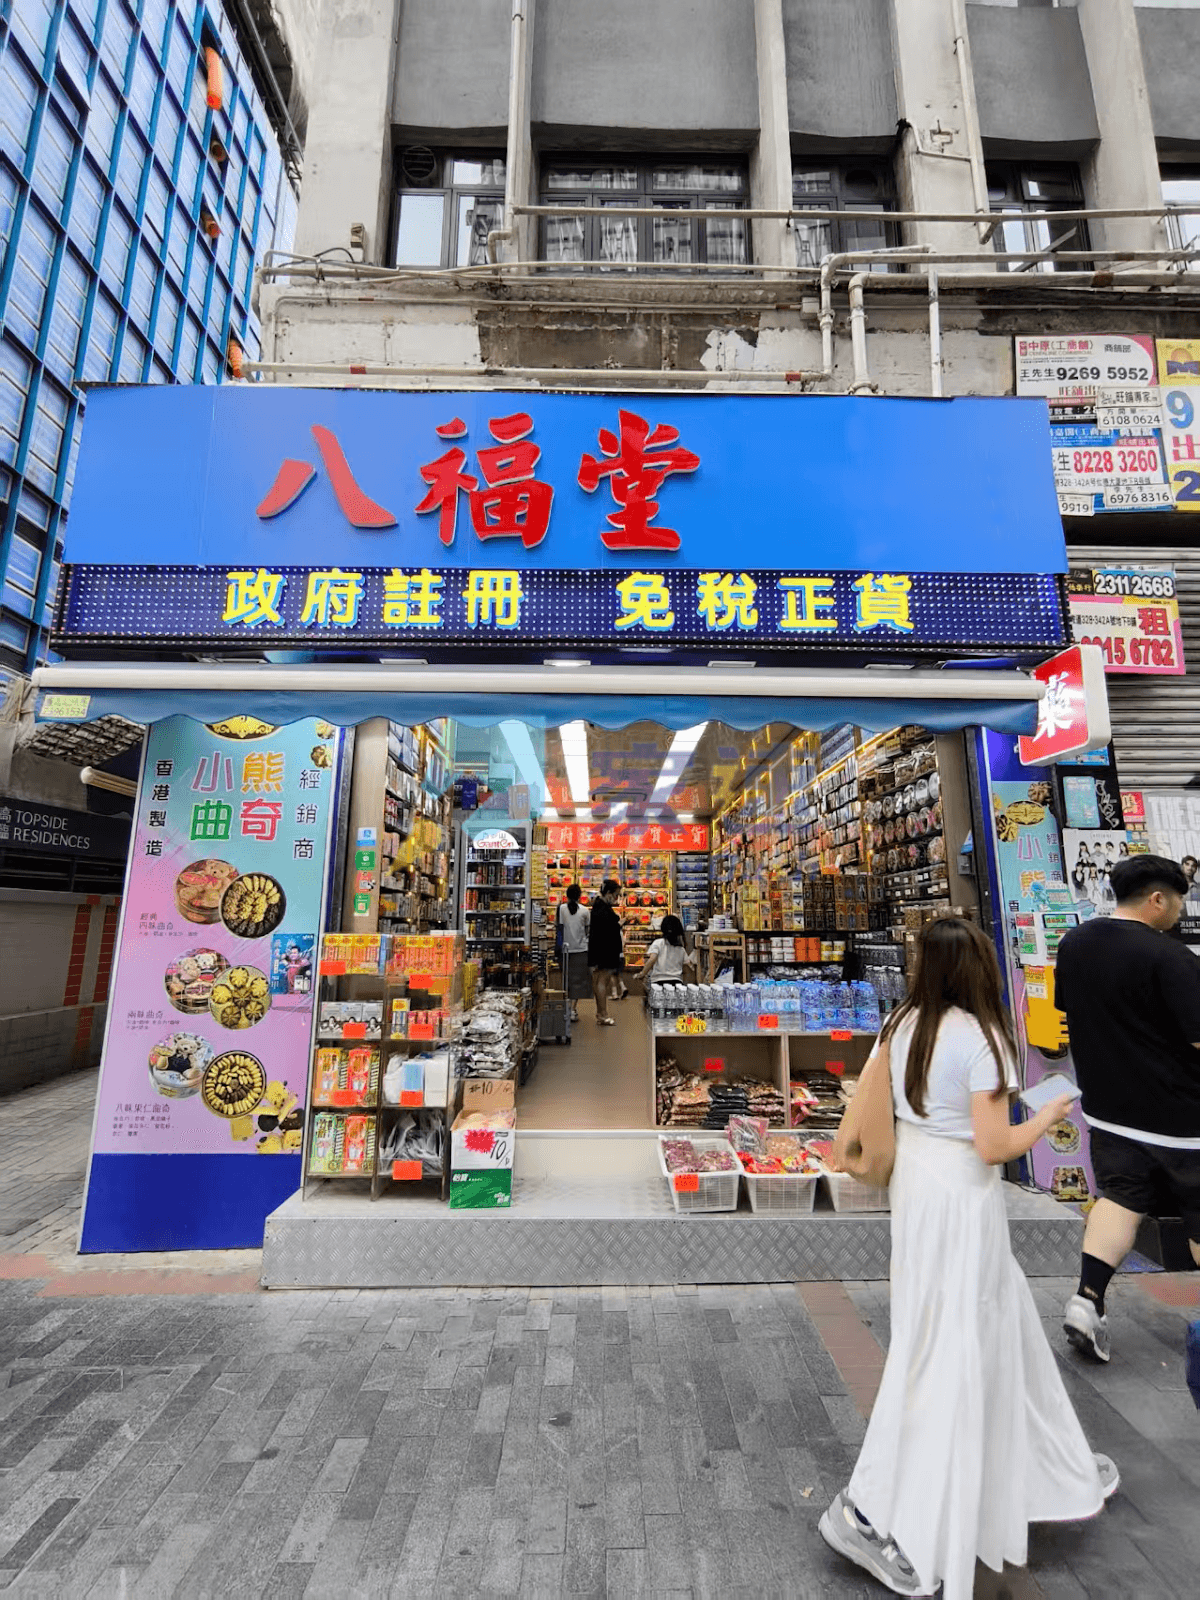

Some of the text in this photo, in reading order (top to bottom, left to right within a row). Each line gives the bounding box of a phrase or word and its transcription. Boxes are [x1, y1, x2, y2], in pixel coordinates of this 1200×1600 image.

[1020, 367, 1148, 381] 王先生 9269 5952
[1103, 416, 1130, 425] 6108
[1133, 415, 1161, 424] 0624
[1073, 450, 1114, 474] 8228
[1117, 449, 1157, 473] 3260
[256, 408, 700, 552] 八福堂
[1061, 502, 1089, 513] 9919
[1110, 492, 1169, 504] 6976 8316
[1094, 574, 1174, 598] 2311 2668
[222, 567, 914, 636] 政府註冊 免稅正貨
[1138, 608, 1170, 636] 租
[1081, 636, 1174, 667] 15 6782
[191, 751, 286, 794] 小熊
[15, 809, 68, 831] TOPSIDE
[145, 759, 173, 857] 香港製造
[190, 797, 284, 842] 曲奇
[293, 769, 321, 860] 經銷商
[13, 827, 90, 850] RESIDENCES
